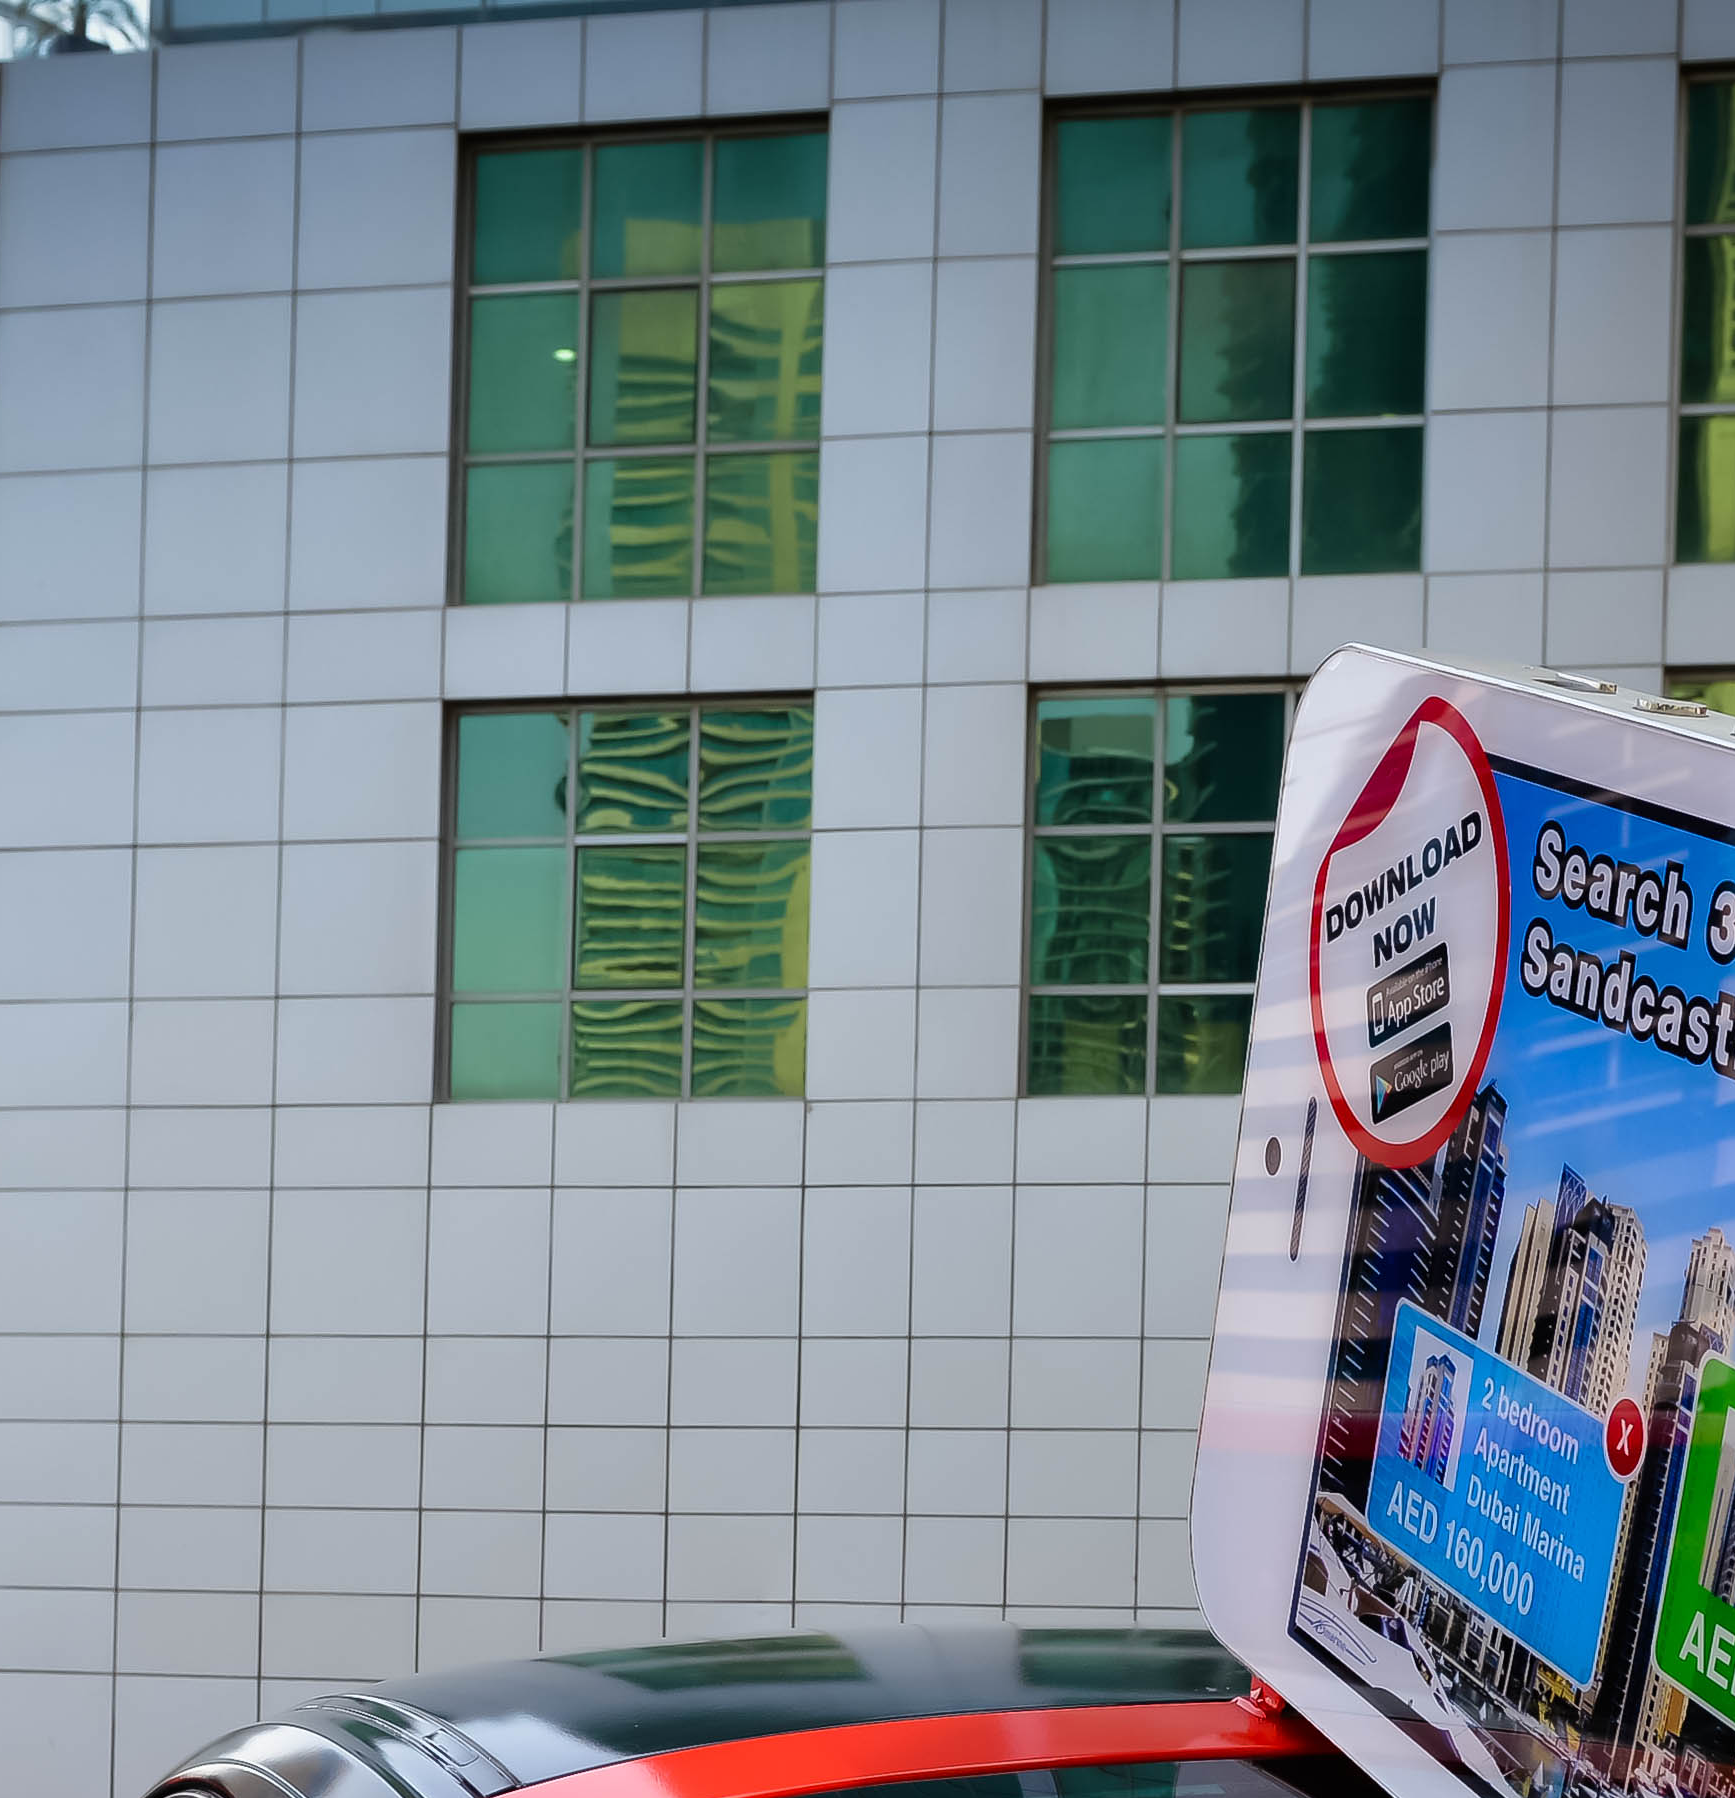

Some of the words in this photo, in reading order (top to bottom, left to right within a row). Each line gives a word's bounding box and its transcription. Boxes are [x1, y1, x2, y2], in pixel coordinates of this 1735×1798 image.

[1325, 811, 1482, 944] DOWNLOAD
[1532, 825, 1692, 944] Search
[1372, 895, 1437, 969] NOW
[1387, 997, 1412, 1028] App
[1413, 976, 1445, 1010] Store
[1394, 1059, 1428, 1093] Google
[1430, 1049, 1450, 1080] play
[1482, 1377, 1495, 1411] 2
[1496, 1385, 1579, 1464] bedroom
[1473, 1427, 1571, 1515] Apartment
[1386, 1480, 1439, 1545] AED
[1444, 1519, 1535, 1616] 160,000
[1466, 1474, 1521, 1537] Dubai
[1521, 1511, 1587, 1583] Marina
